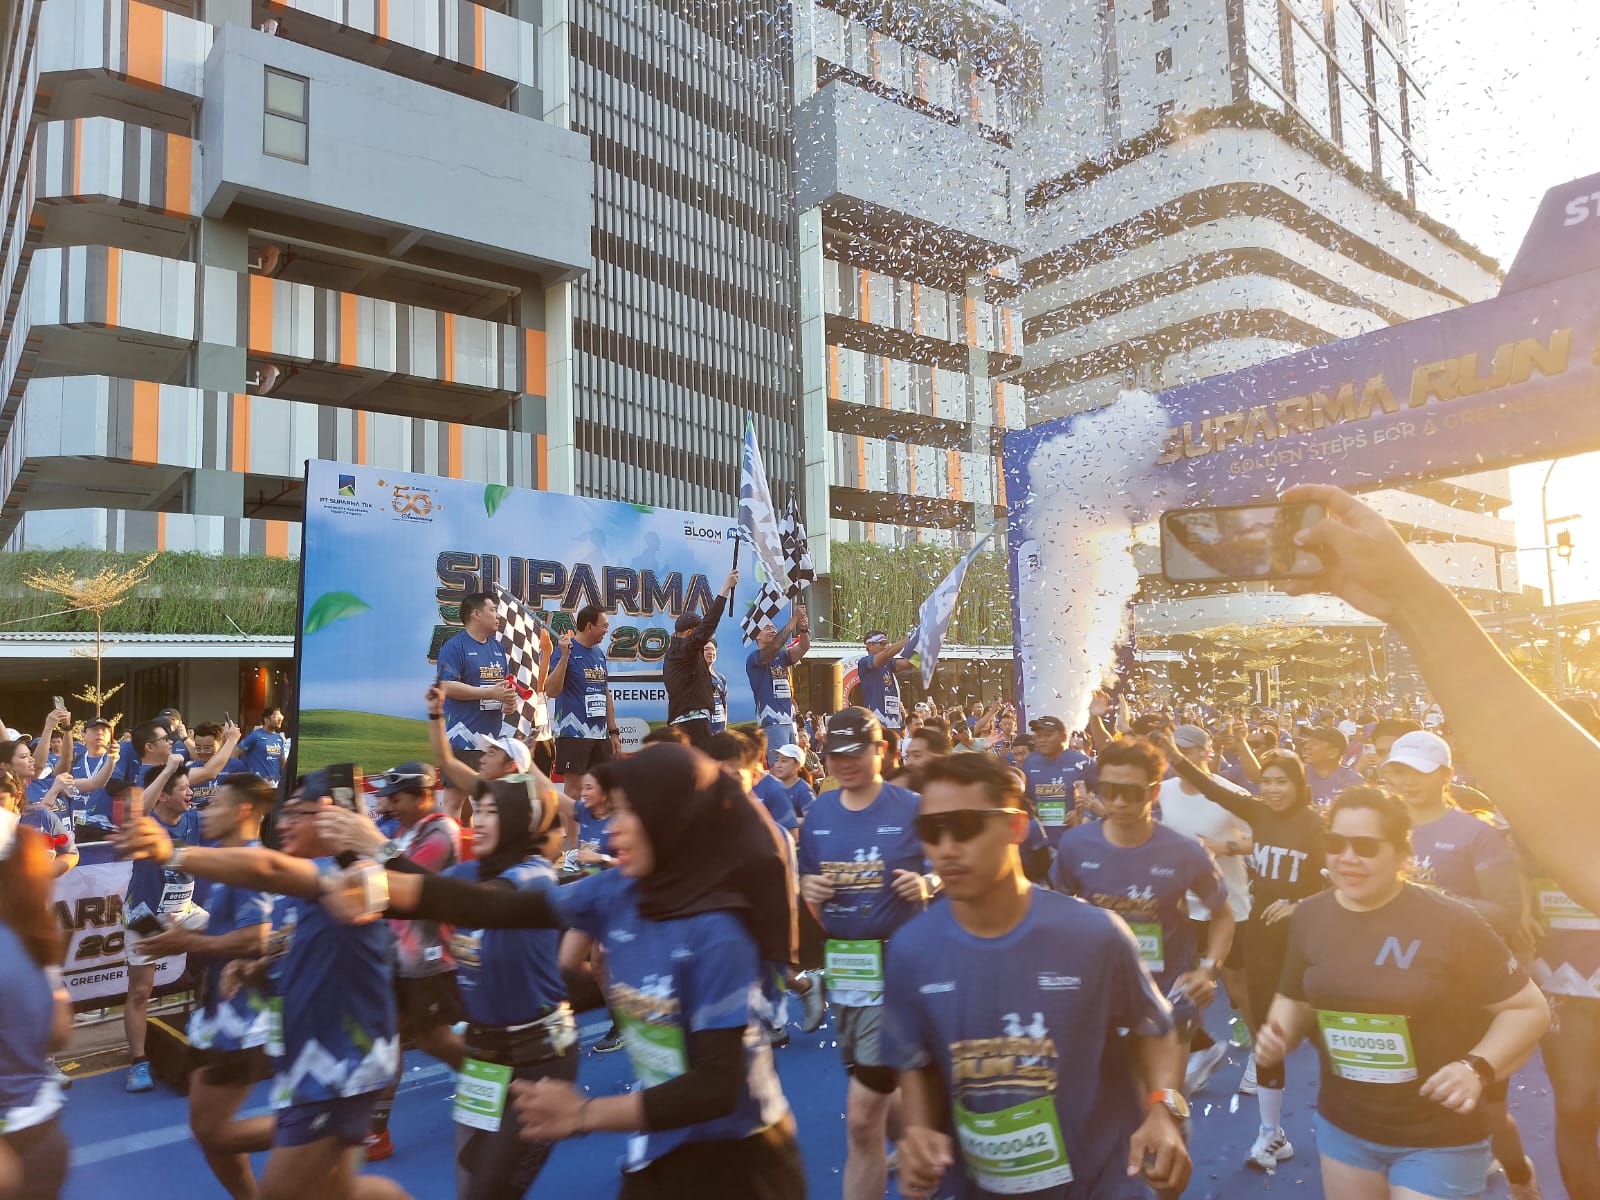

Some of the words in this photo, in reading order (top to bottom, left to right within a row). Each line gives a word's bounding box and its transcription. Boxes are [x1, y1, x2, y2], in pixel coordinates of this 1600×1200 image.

[1156, 372, 1399, 466] SUPARMA
[1408, 328, 1572, 409] RUN
[1308, 431, 1368, 459] STEPS
[684, 526, 722, 540] BLOOM
[435, 550, 718, 618] SUPARMA
[70, 970, 124, 987] GREENER
[1331, 1034, 1397, 1051] F100098
